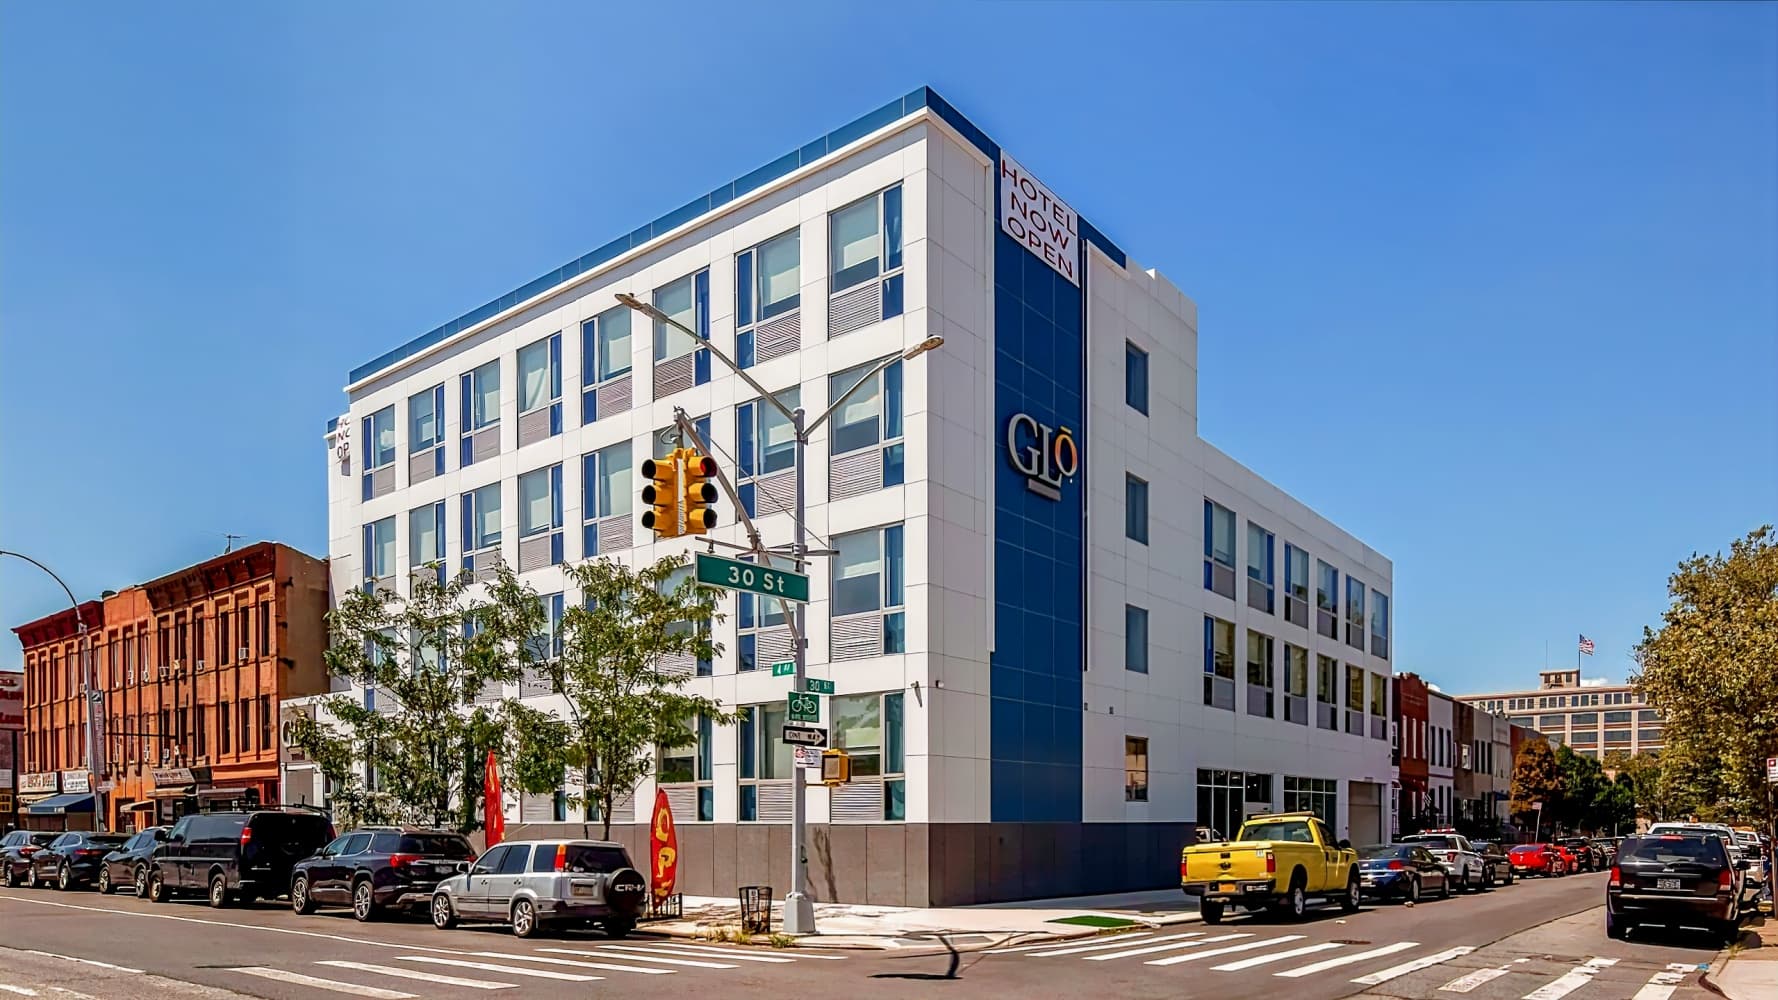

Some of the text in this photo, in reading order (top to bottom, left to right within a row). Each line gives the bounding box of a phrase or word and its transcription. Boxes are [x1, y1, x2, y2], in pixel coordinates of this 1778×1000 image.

[1002, 159, 1077, 237] HOTEL
[1010, 191, 1069, 250] NOW
[1007, 217, 1073, 278] OPEN
[728, 566, 785, 593] 30 St
[809, 680, 820, 691] 30
